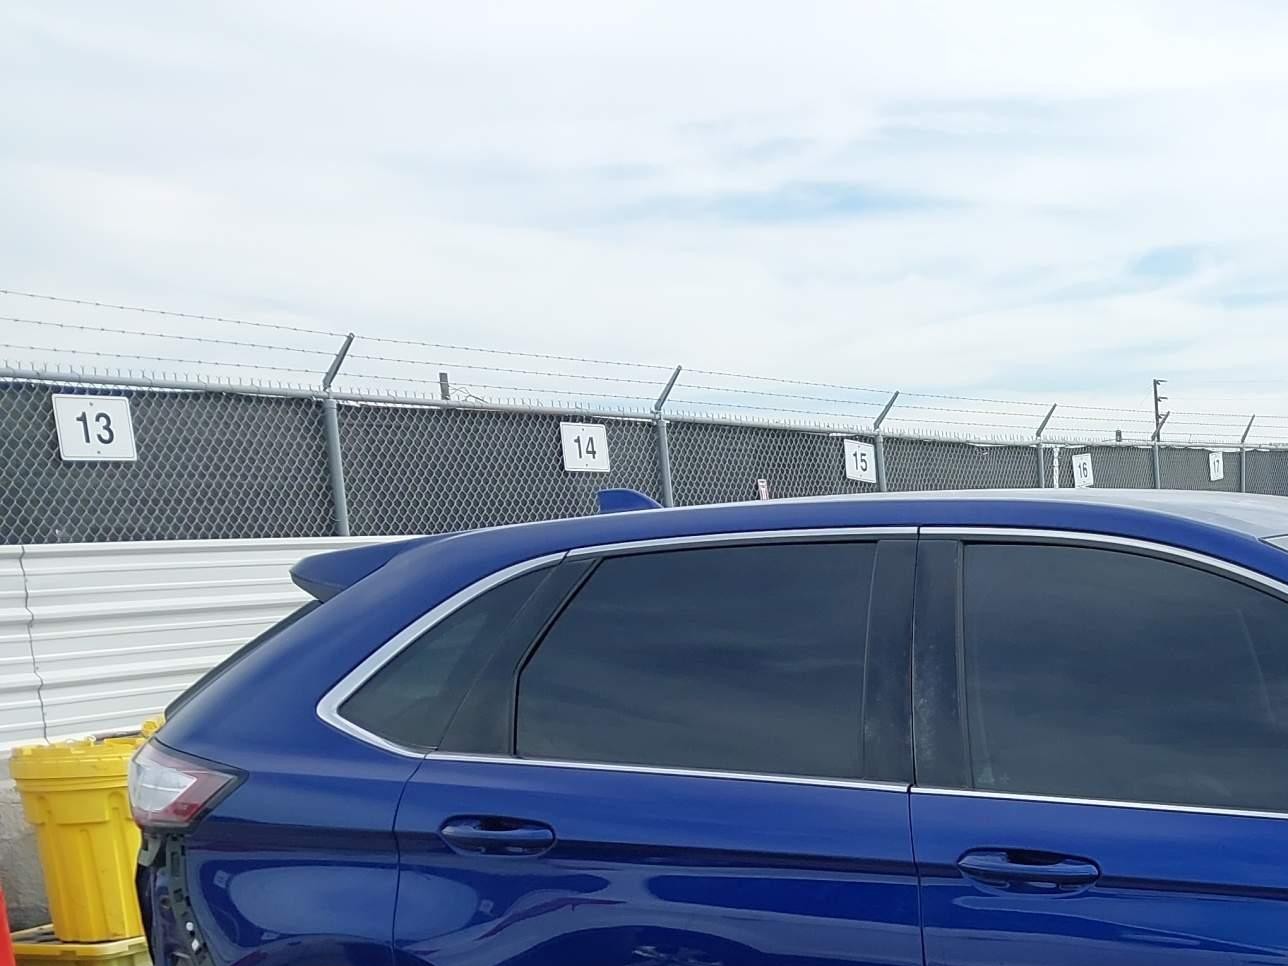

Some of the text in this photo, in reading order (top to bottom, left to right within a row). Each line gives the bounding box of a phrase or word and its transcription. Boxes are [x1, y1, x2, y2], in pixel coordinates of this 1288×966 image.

[75, 410, 115, 445] 13
[573, 434, 597, 460] 14
[852, 450, 868, 472] 15
[1078, 461, 1089, 478] 16
[1213, 459, 1220, 473] 17
